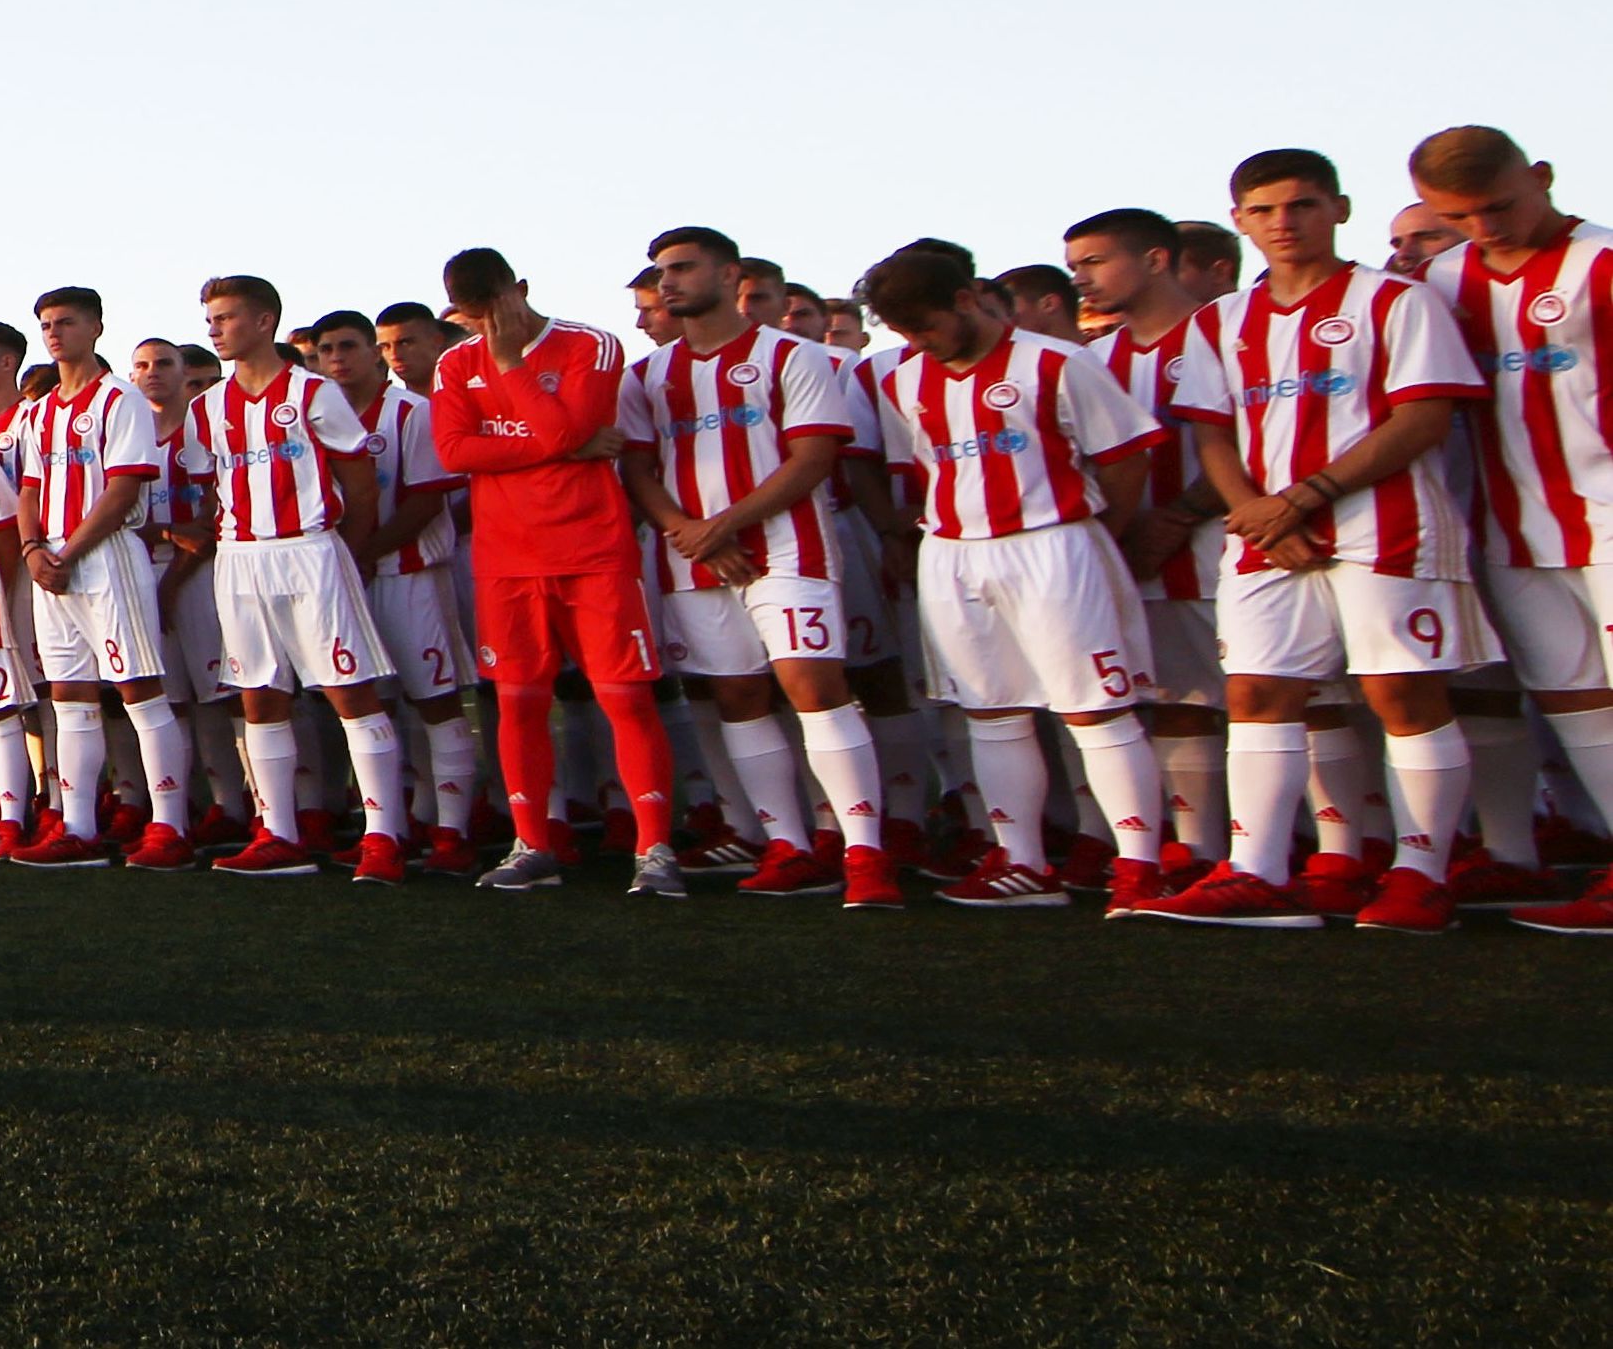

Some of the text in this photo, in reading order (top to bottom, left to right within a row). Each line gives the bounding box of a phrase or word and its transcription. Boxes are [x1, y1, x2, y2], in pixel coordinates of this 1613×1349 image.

[479, 414, 535, 437] nice
[782, 607, 830, 652] 13
[850, 616, 879, 654] 2
[1407, 607, 1444, 659] 9
[105, 639, 124, 673] 8
[332, 637, 357, 675] 6
[422, 647, 452, 686] 2
[631, 629, 652, 671] 1
[1091, 650, 1132, 698] 5
